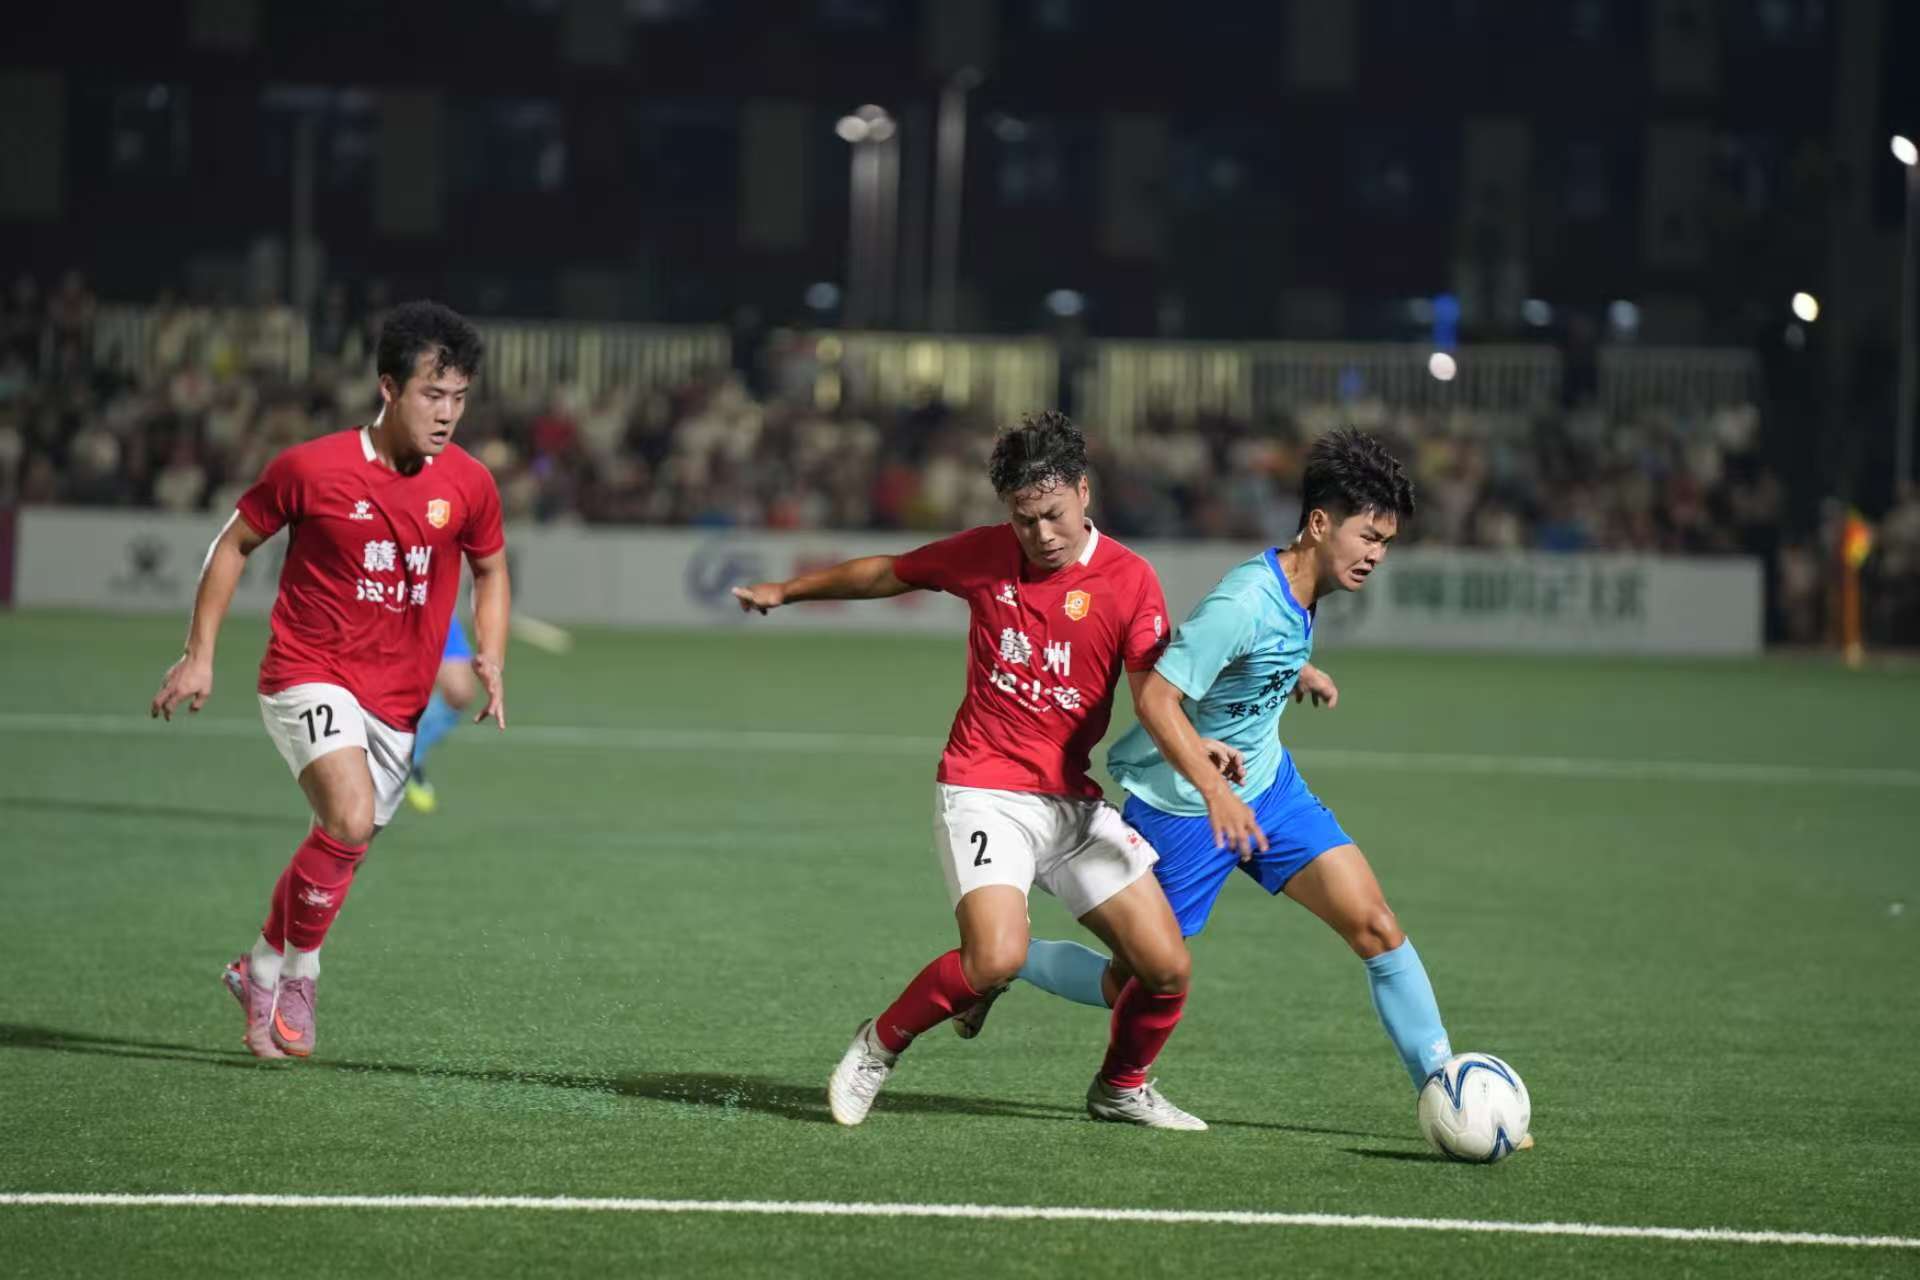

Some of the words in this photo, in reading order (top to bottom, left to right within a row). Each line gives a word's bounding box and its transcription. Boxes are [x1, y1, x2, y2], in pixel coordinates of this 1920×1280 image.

[363, 540, 433, 575] 赣州
[998, 627, 1072, 677] 赣州
[969, 830, 992, 867] 2
